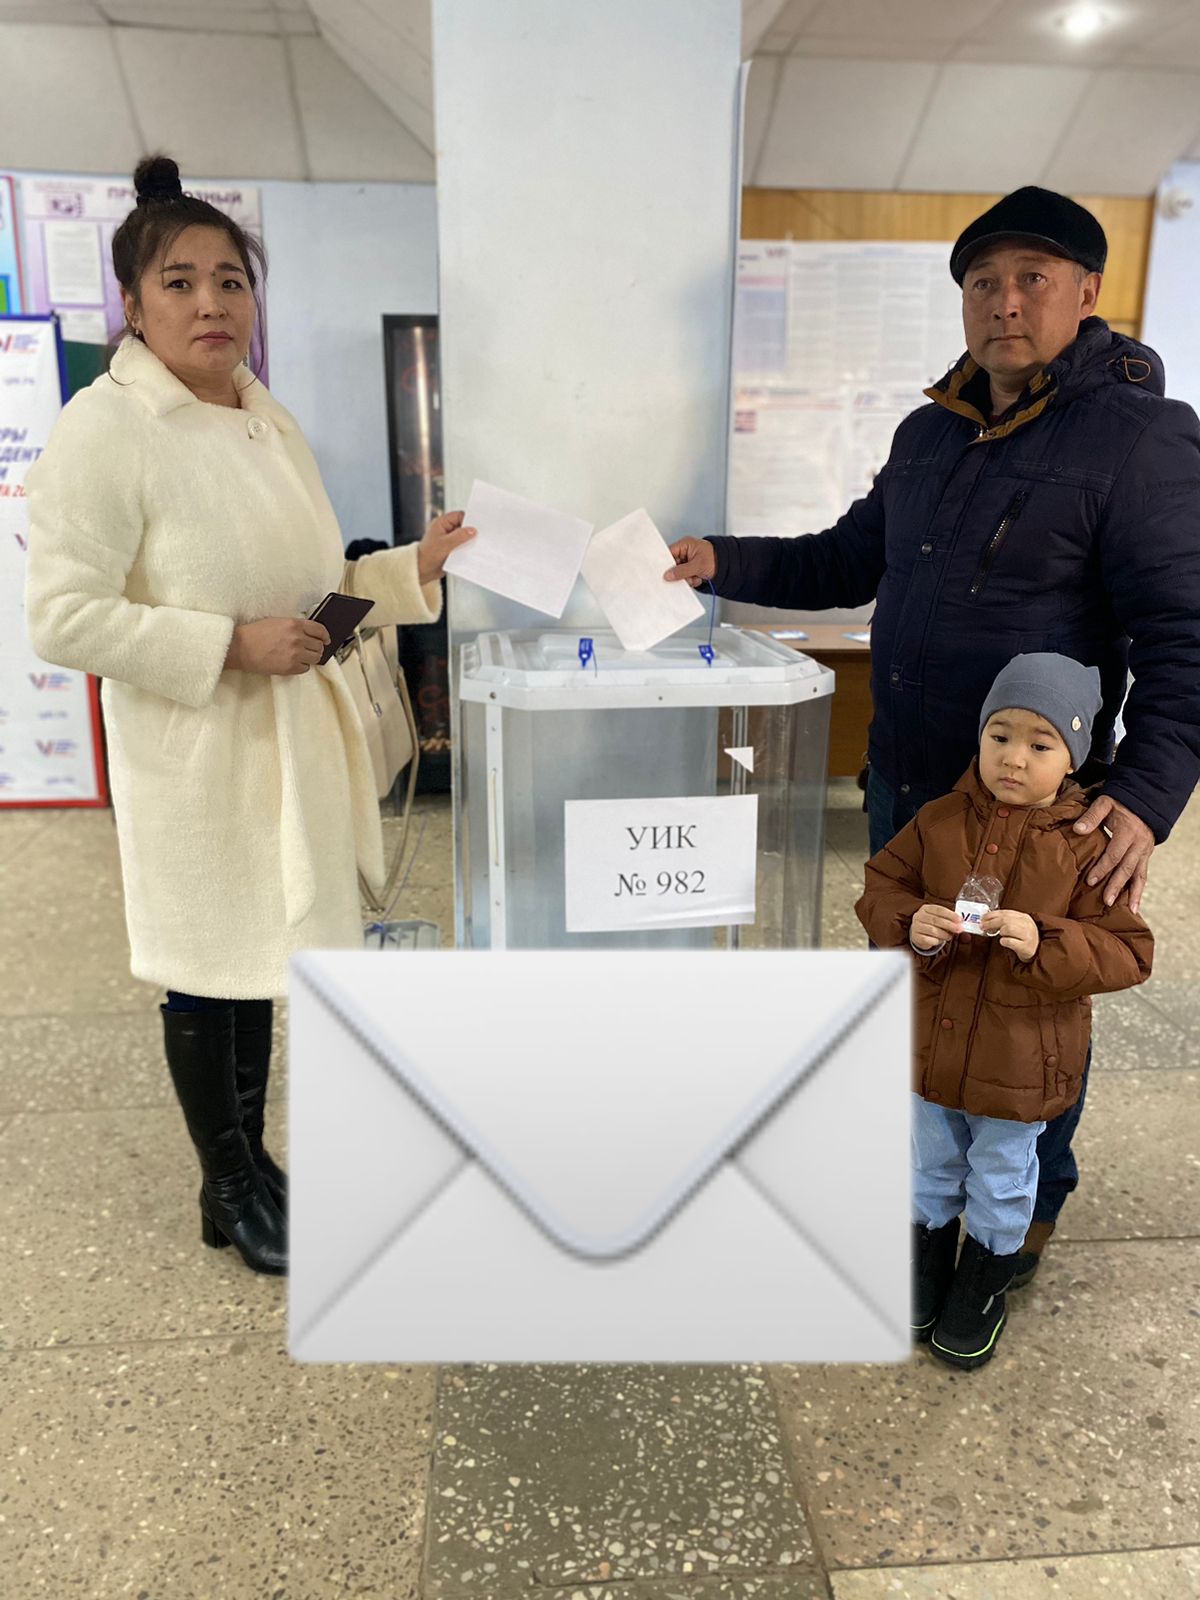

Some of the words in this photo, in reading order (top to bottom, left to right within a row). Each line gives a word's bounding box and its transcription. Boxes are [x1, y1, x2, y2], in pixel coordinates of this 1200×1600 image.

[625, 824, 697, 851] УИК
[614, 873, 647, 897] №
[656, 870, 706, 895] 982
